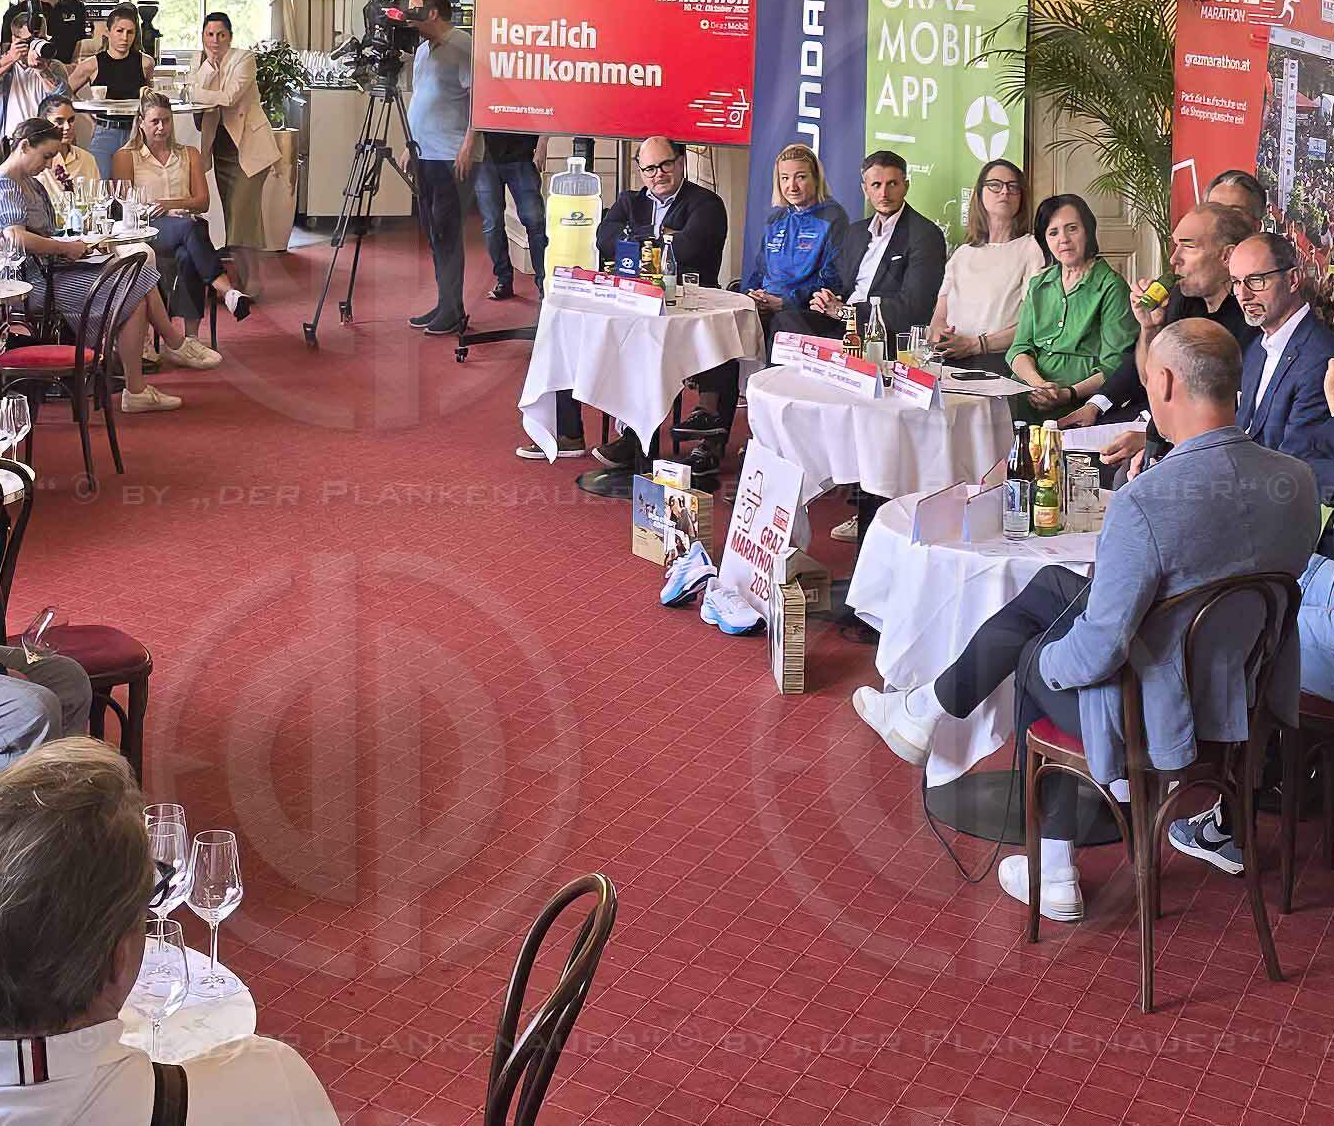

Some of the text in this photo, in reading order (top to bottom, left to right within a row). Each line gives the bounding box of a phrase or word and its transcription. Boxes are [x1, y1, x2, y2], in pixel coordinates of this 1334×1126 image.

[1200, 6, 1246, 23] MARATHON
[490, 17, 597, 49] Herzlich
[877, 18, 990, 69] MOBIL
[489, 50, 662, 87] Willkommen
[1184, 53, 1252, 72] grazmarathon.at
[874, 73, 939, 120] APP
[730, 529, 774, 574] MARATHO
[760, 526, 785, 555] GRAZ
[750, 571, 770, 602] 2025
